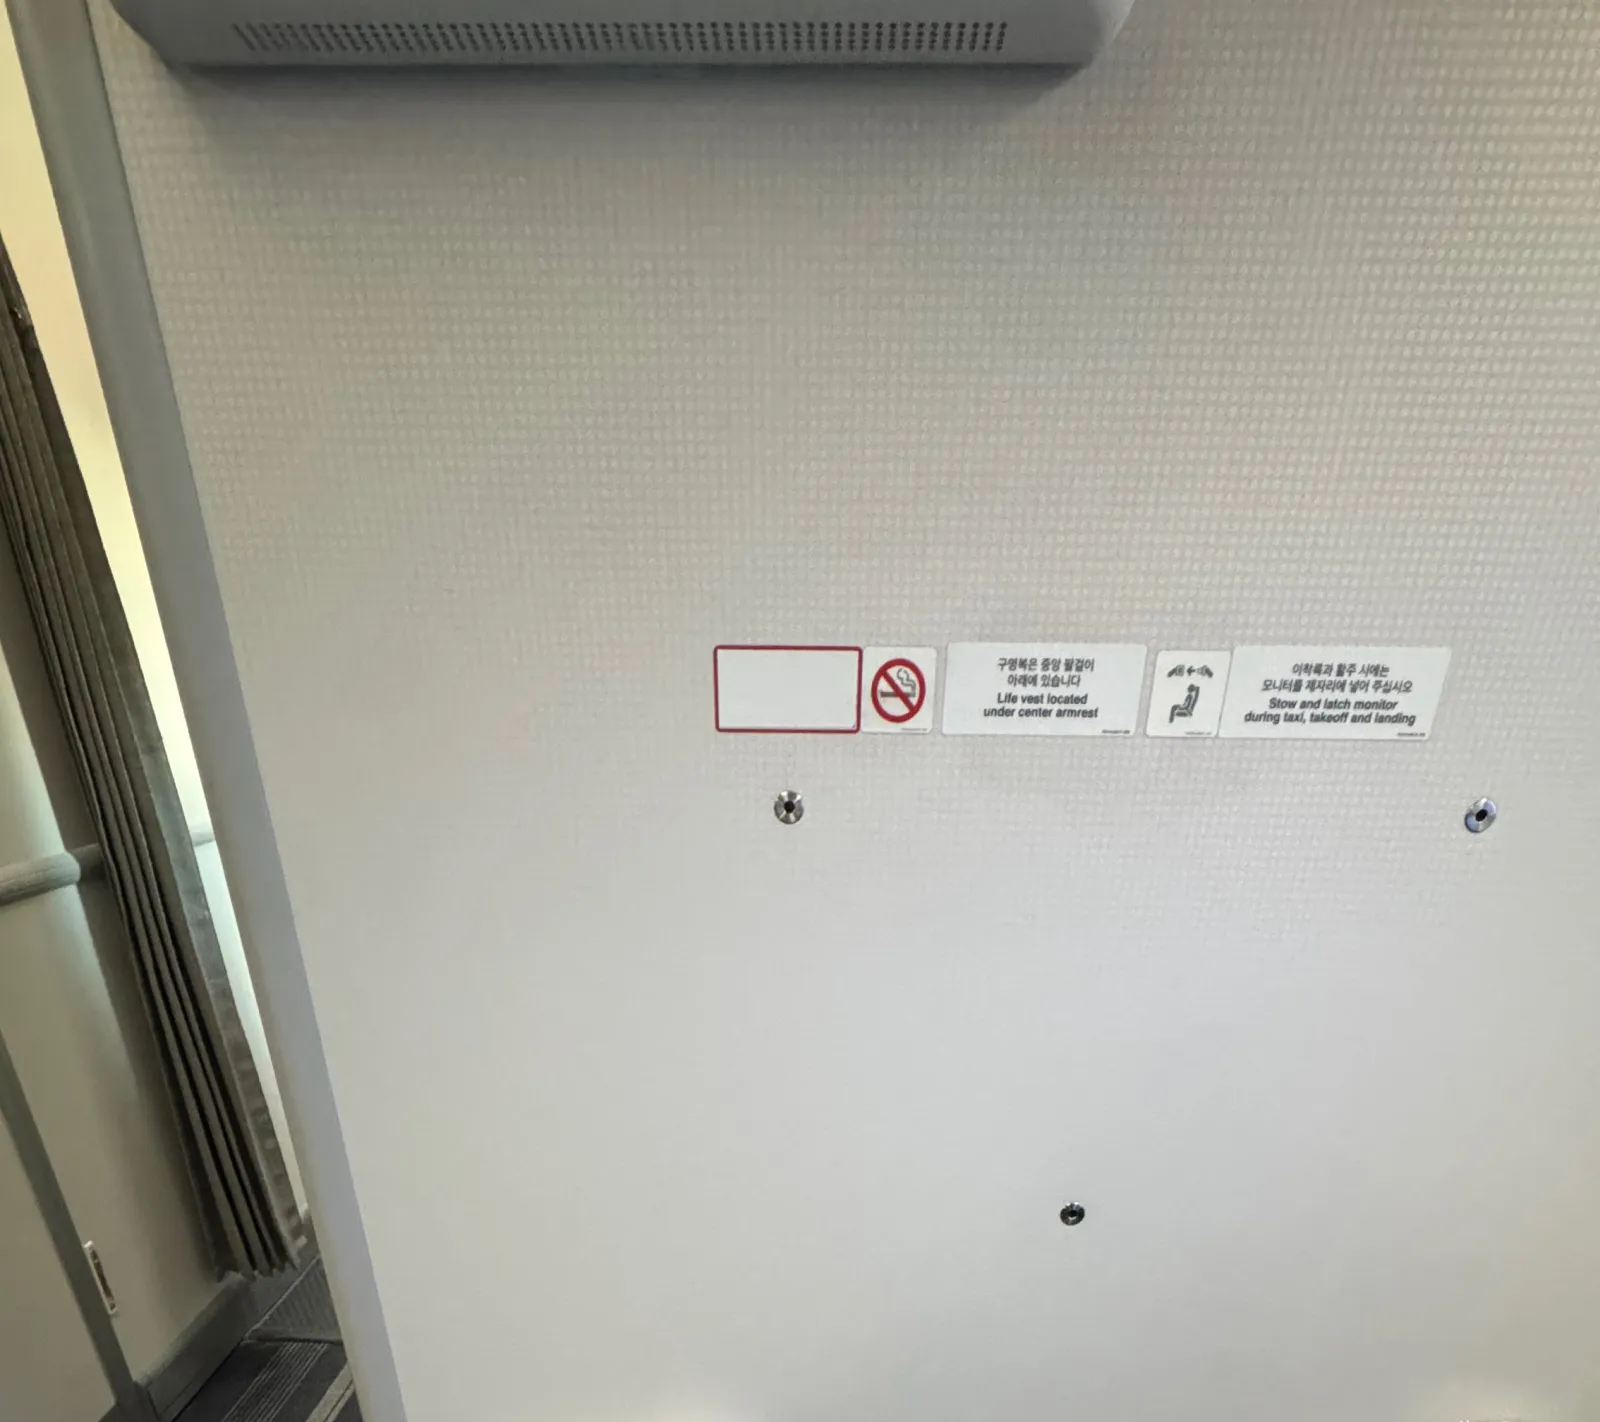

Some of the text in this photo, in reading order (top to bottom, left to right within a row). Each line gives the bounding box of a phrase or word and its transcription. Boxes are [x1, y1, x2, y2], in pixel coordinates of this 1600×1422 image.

[998, 657, 1095, 672] 구명복은 중앙 팔걸이
[1358, 663, 1390, 677] 시에는
[1007, 674, 1081, 688] 아래에 있습니다
[1261, 679, 1303, 692] 모니터를
[1305, 679, 1347, 692] 제자리에
[1372, 680, 1413, 694] 주십시오
[997, 692, 1088, 704] Life vest located
[1269, 697, 1398, 710] Stow and latch monitor
[983, 707, 1098, 718] under center armrest
[1244, 711, 1416, 726] during taxi, takeoff and landing
